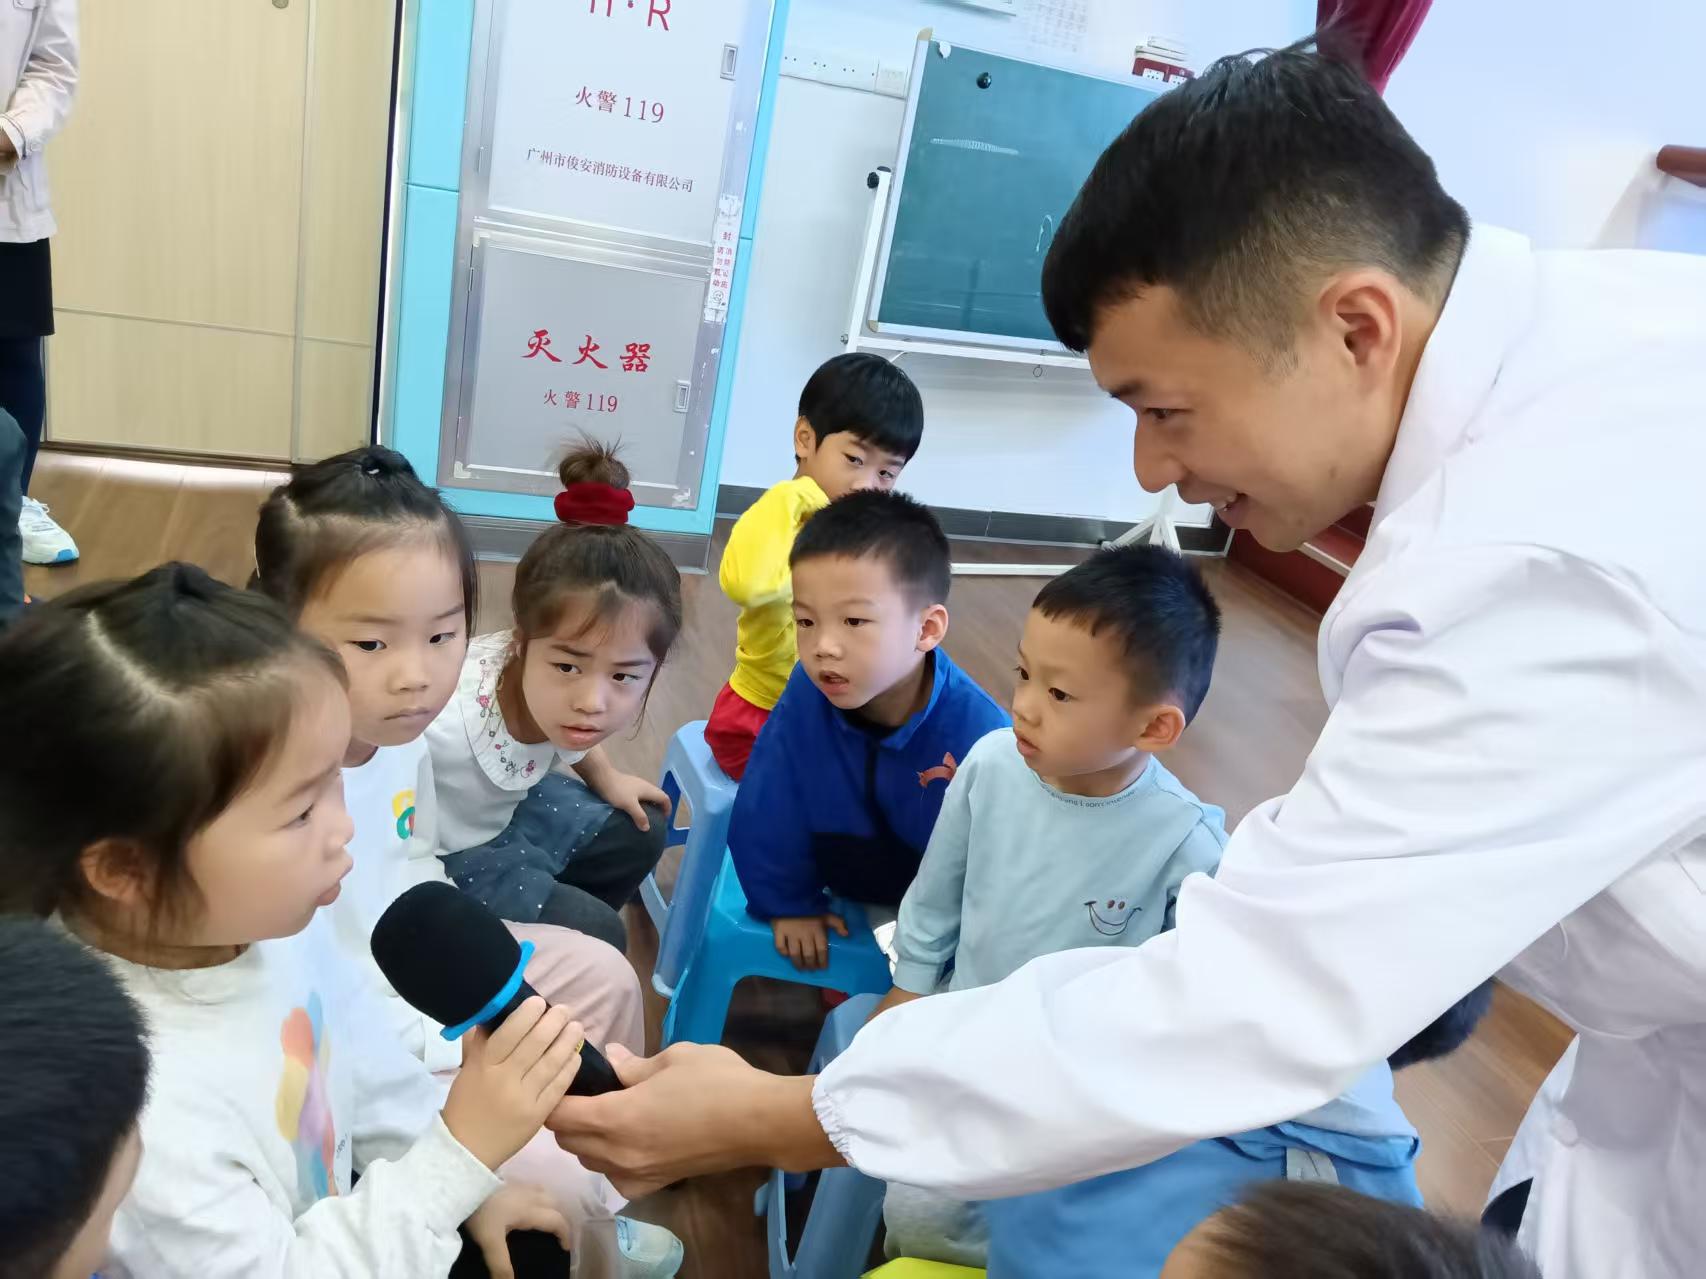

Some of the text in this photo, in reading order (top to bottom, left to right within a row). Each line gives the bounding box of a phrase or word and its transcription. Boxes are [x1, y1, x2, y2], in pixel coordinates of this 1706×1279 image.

[576, 86, 664, 123] 火警119
[527, 148, 693, 193] 广州市俊安消防设备有限公司
[520, 329, 651, 372] 灭火器
[544, 389, 617, 412] 火警119
